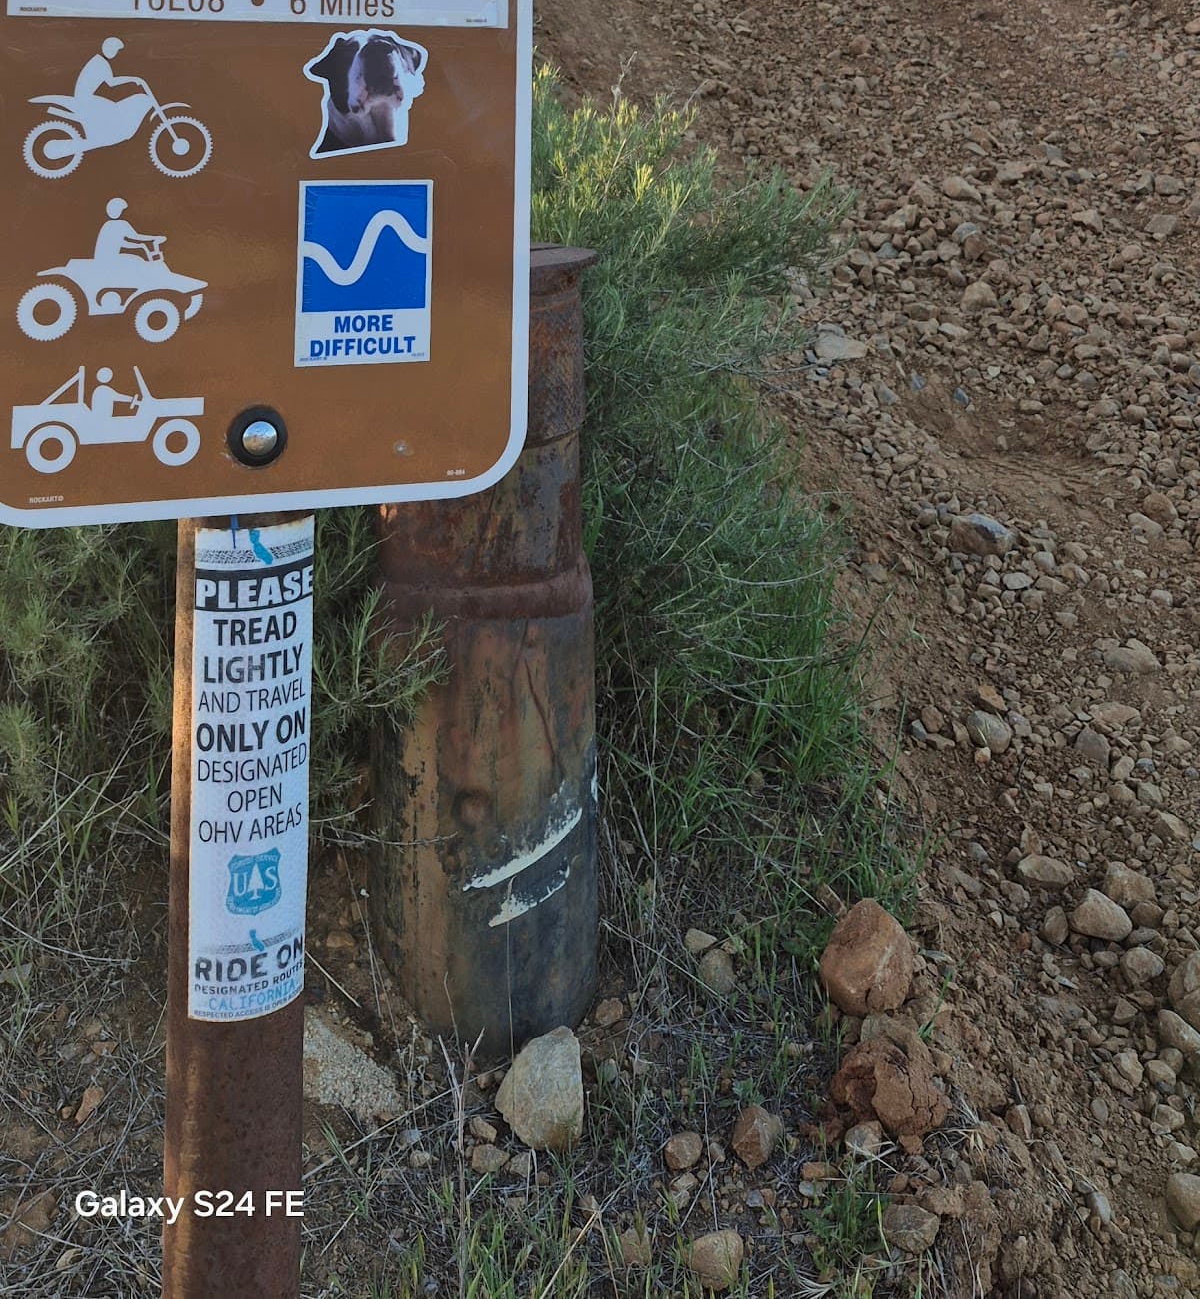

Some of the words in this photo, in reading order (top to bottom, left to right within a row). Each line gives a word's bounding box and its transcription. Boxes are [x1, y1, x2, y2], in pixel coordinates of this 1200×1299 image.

[334, 314, 393, 333] MORE
[310, 336, 416, 357] DIFFICULT
[195, 565, 313, 608] PLEASE
[213, 611, 297, 646] TREAD
[203, 643, 303, 684] LIGHTLY
[198, 690, 240, 713] AND
[246, 677, 306, 712] TRAVEL
[196, 719, 270, 752] ONLY
[276, 707, 306, 744] ON
[197, 742, 307, 783] DESIGNATED
[227, 783, 282, 813] OPEN
[198, 820, 242, 843] OHV
[249, 803, 302, 842] AREAS
[195, 952, 268, 982] RIDE
[276, 933, 304, 969] ON
[194, 980, 269, 995] DESIGNATED
[208, 978, 296, 1011] CALIFORNIA
